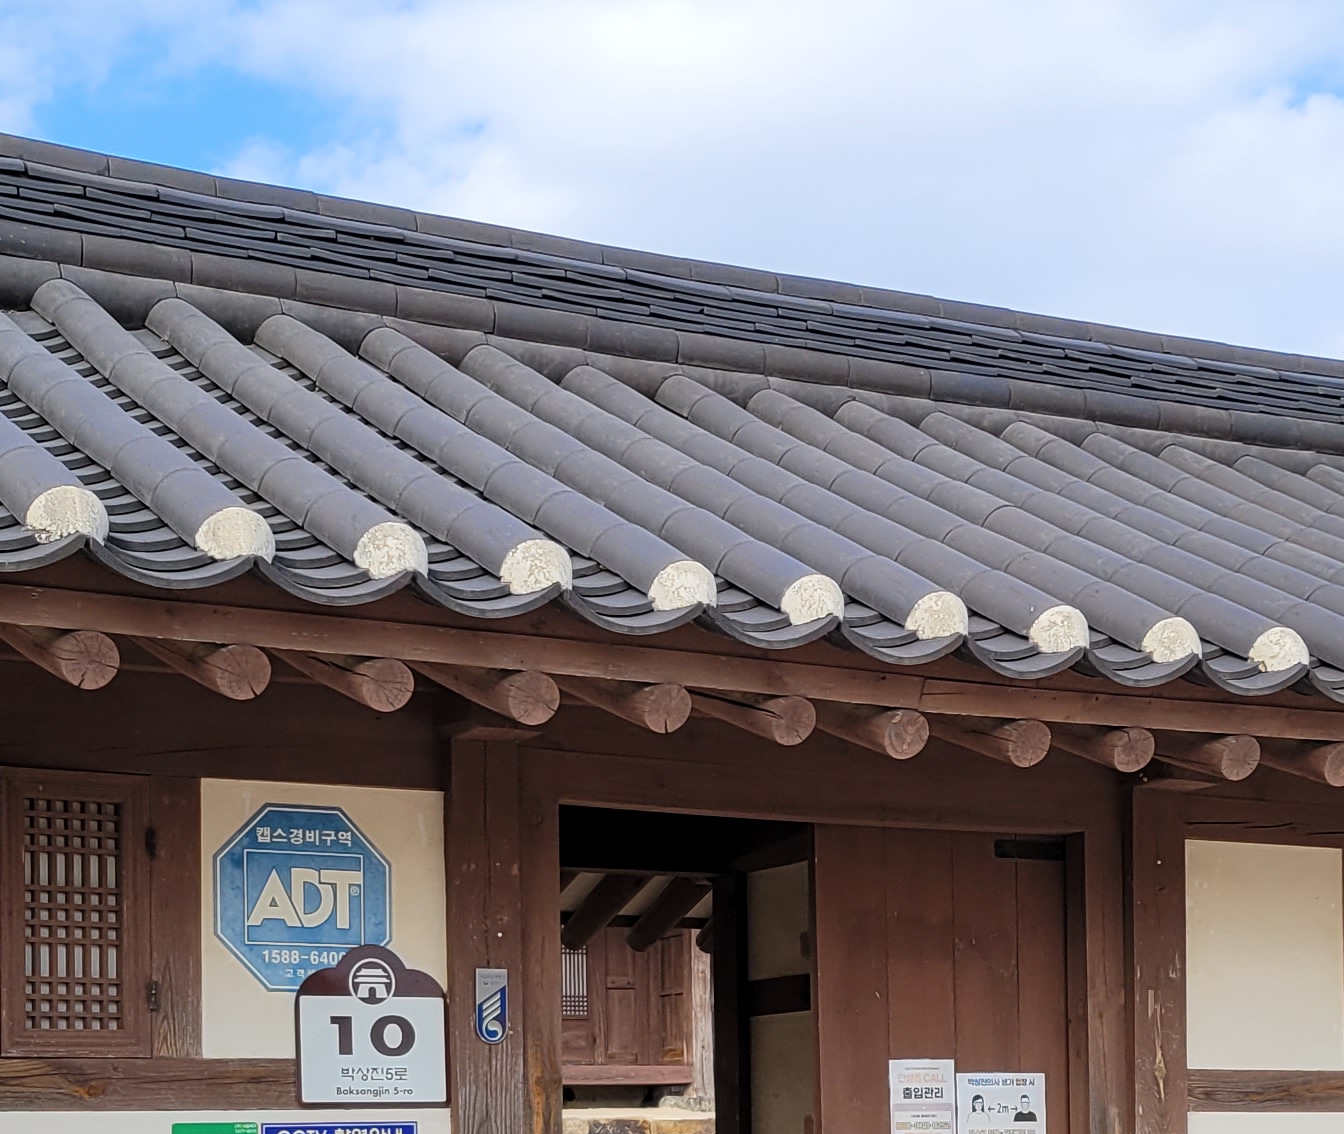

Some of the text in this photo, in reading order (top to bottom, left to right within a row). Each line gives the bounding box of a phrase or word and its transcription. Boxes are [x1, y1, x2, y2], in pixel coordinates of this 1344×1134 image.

[256, 826, 353, 848] 캡스경비구역
[246, 867, 362, 929] ADT
[329, 1015, 416, 1057] 10
[340, 1067, 409, 1082] 박상진5로
[336, 1086, 414, 1098] Baksangjin 5-ro
[902, 1087, 944, 1100] 출입관리
[997, 1103, 1010, 1114] 2m
